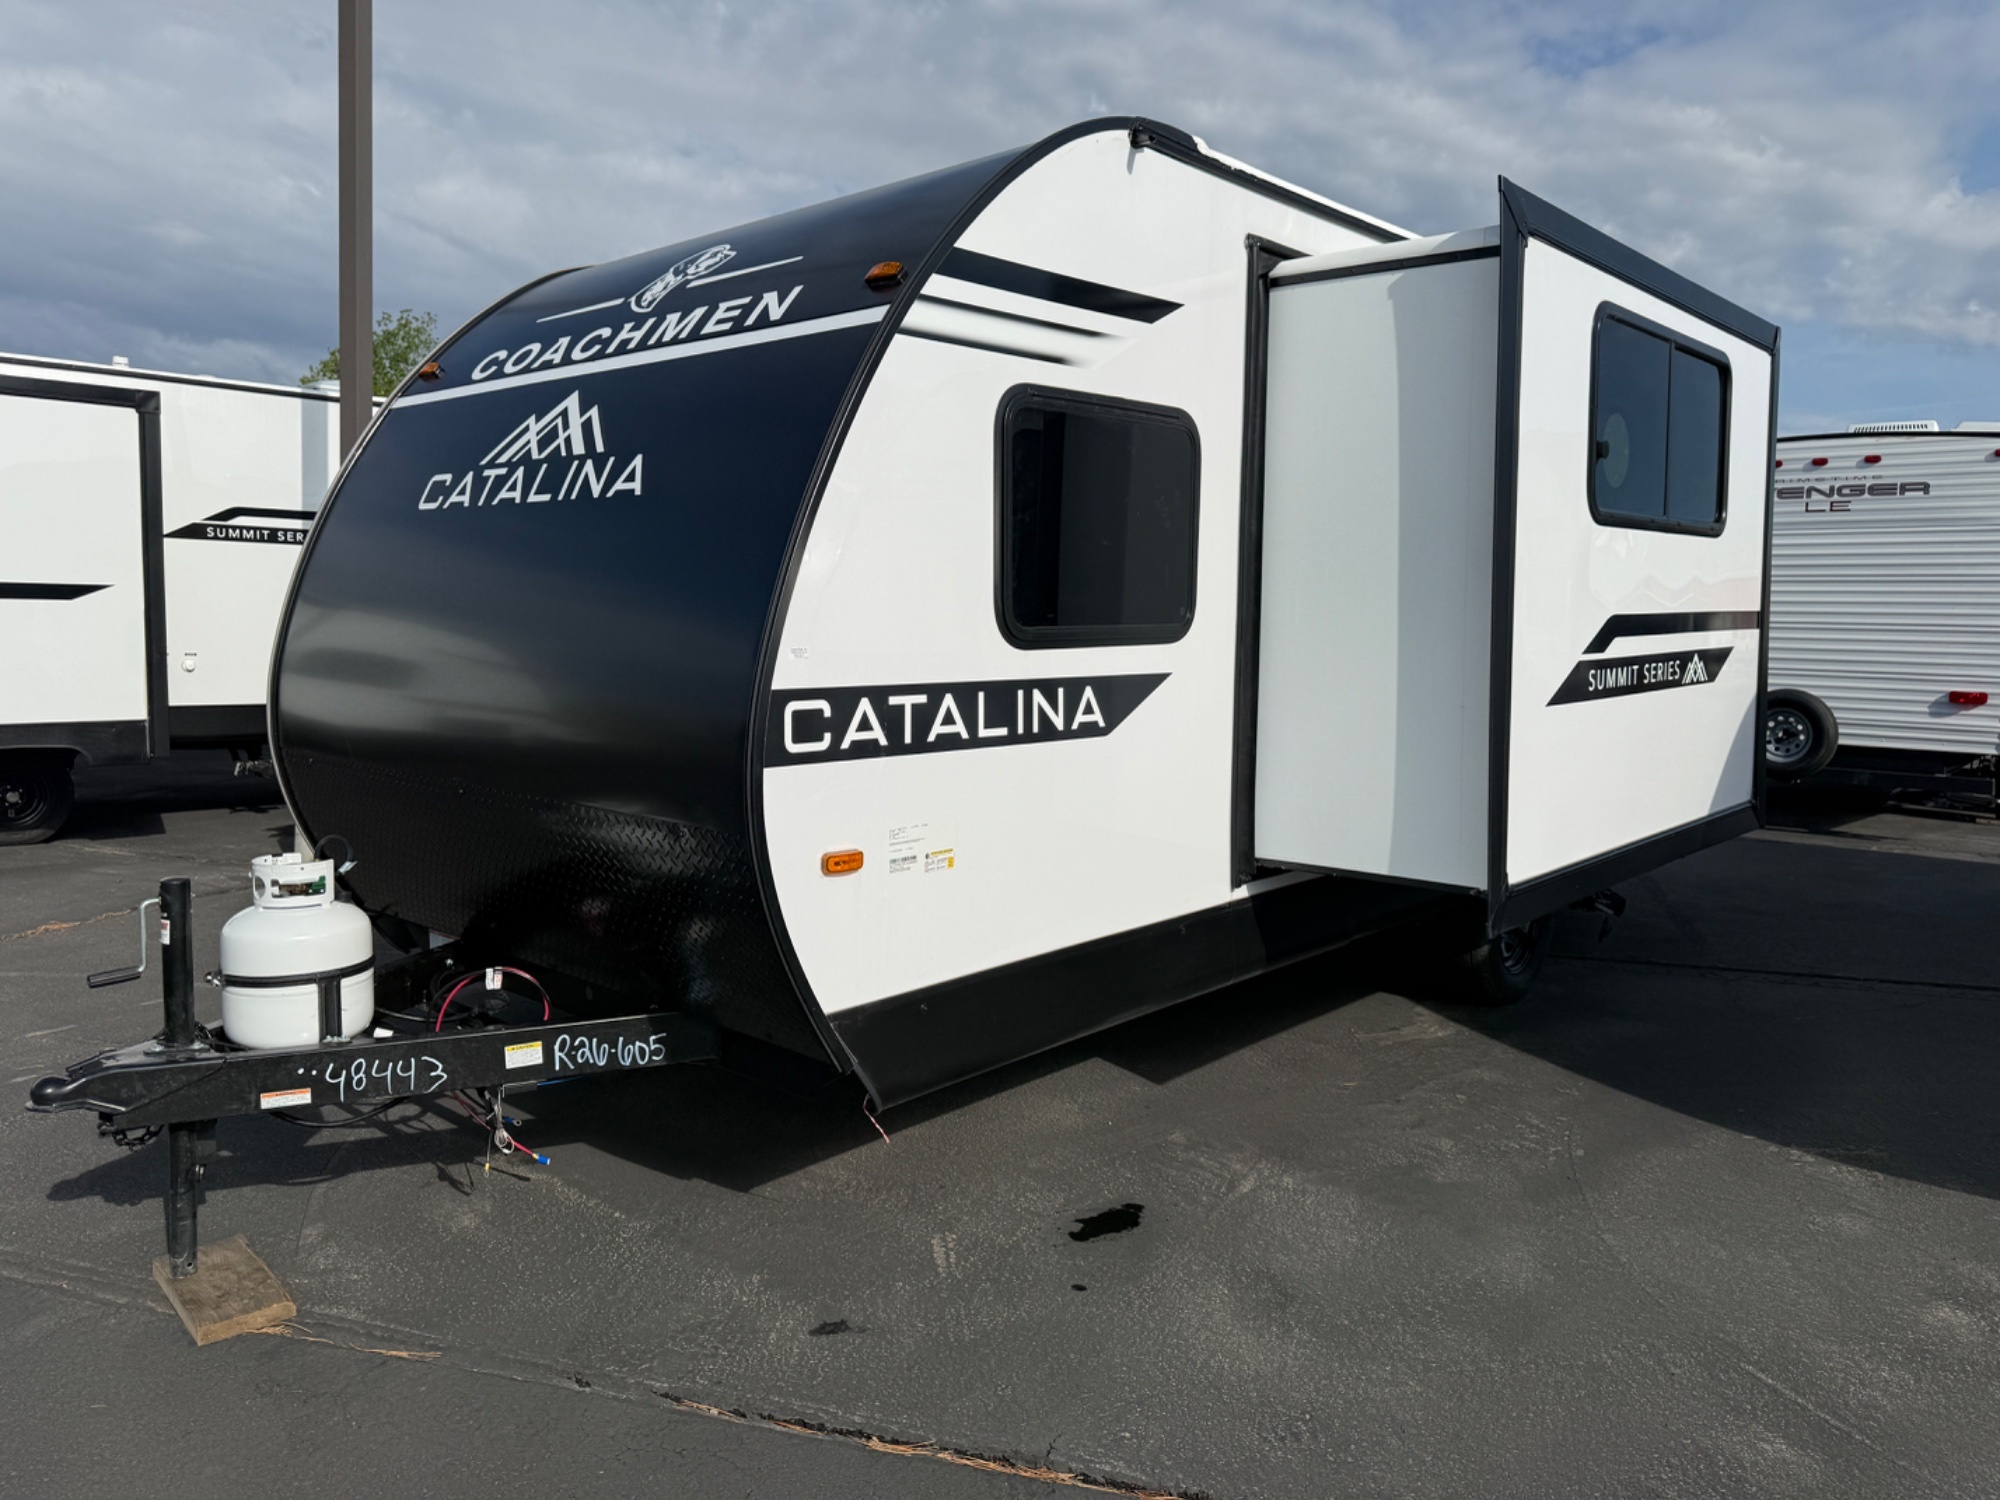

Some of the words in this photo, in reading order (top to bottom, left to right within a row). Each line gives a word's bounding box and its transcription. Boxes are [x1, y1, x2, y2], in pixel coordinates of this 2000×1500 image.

[471, 285, 803, 380] COACHMEN
[418, 454, 643, 510] CATALINA
[1774, 481, 1931, 500] ENGER
[1805, 500, 1851, 513] LE
[206, 526, 270, 541] SUMMIT
[277, 531, 305, 543] SER
[1588, 665, 1639, 692] SUMMIT
[1643, 660, 1681, 684] SERIES
[784, 685, 1105, 754] CATALINA
